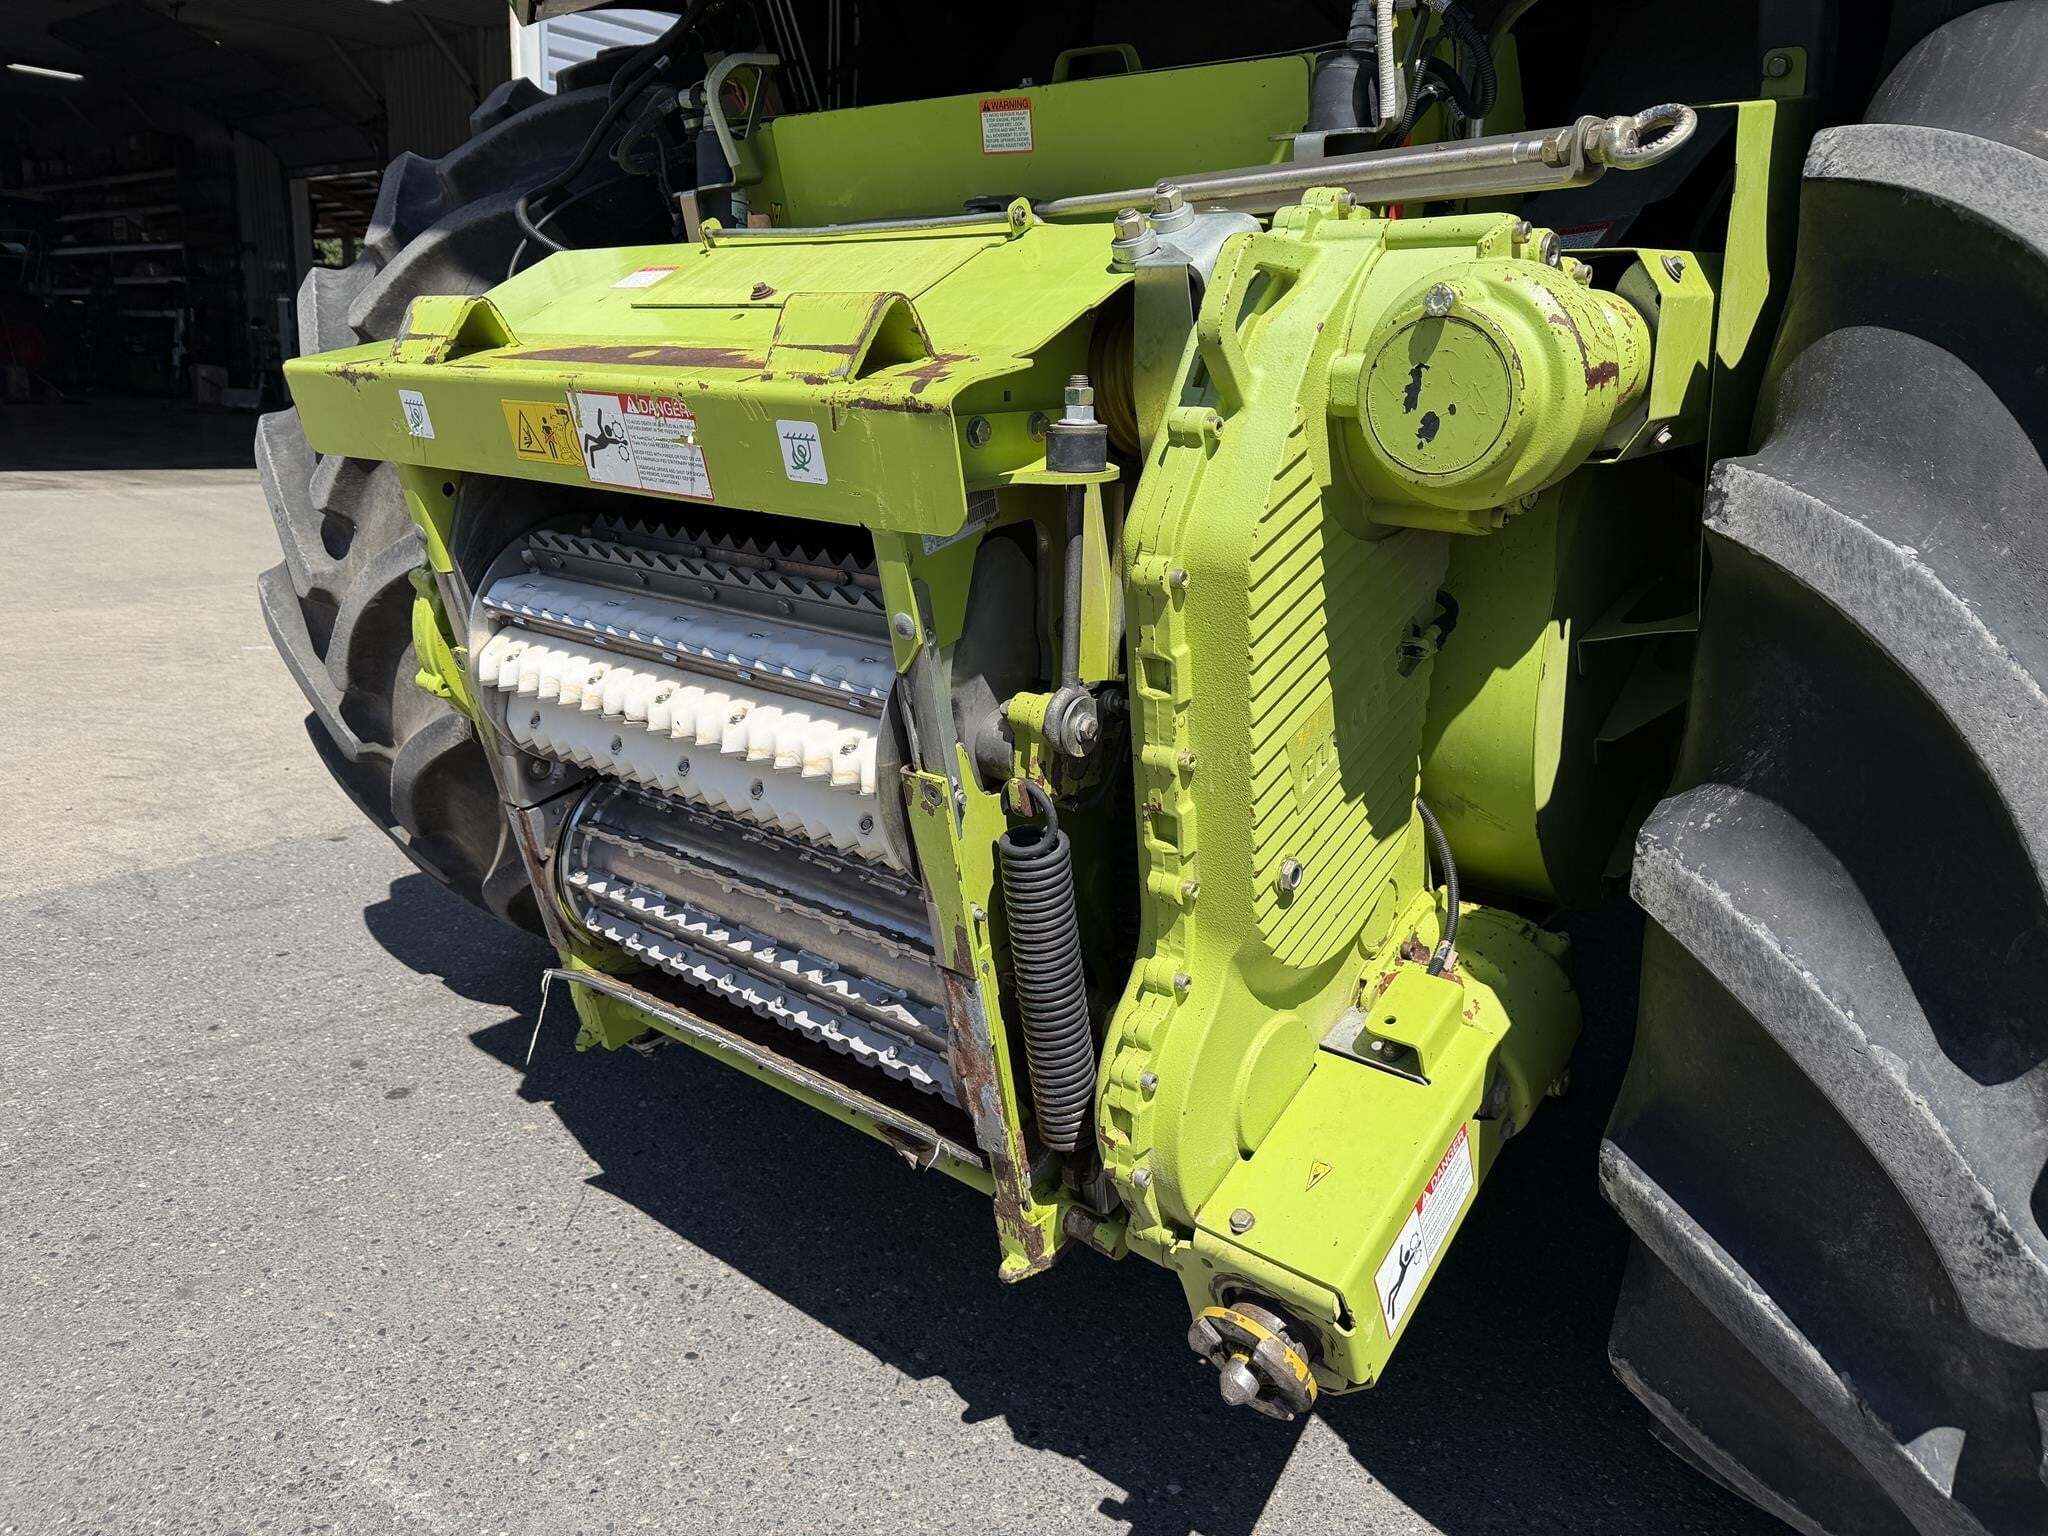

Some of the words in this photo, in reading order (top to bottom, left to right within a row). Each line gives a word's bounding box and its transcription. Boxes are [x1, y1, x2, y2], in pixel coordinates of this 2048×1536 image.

[992, 99, 1029, 110] WARNING
[639, 399, 690, 418] DANGER
[1430, 1130, 1464, 1191] DANGER
